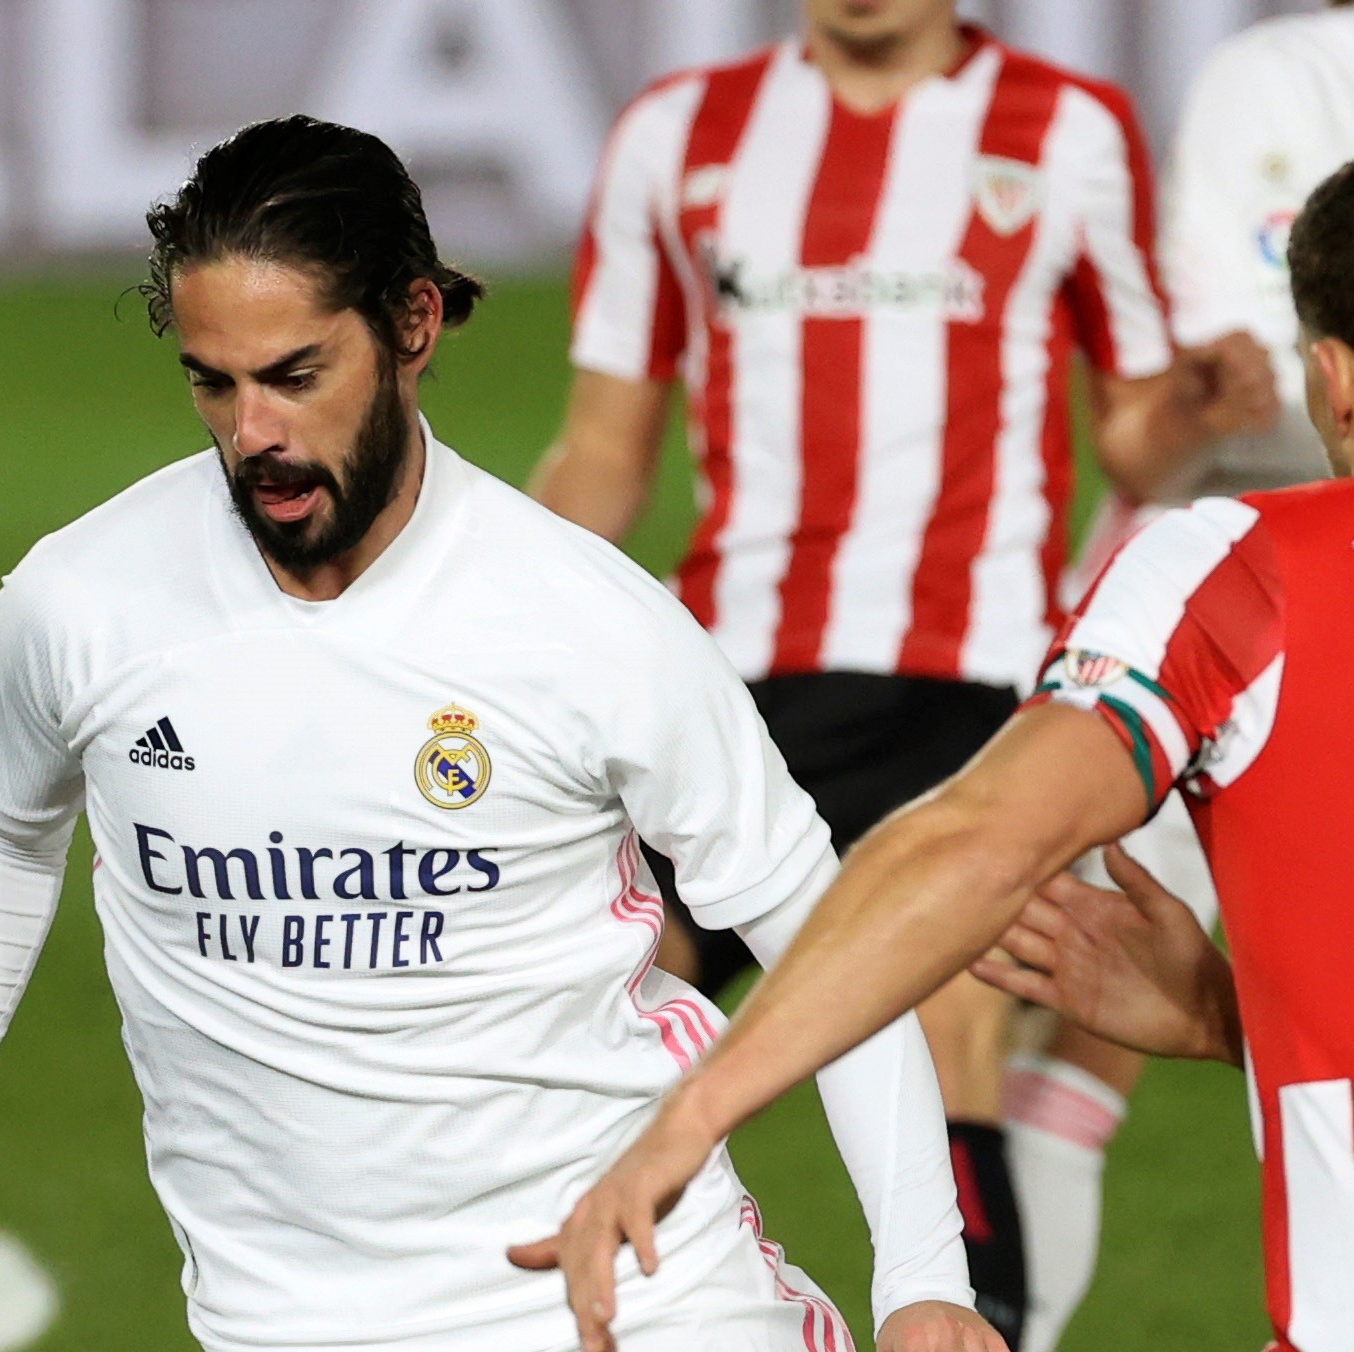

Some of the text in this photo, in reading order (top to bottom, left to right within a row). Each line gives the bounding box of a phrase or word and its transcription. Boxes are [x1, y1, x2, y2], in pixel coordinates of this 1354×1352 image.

[129, 747, 195, 771] adidas
[133, 822, 501, 900] Emirates
[197, 910, 445, 969] FLY BETTER
